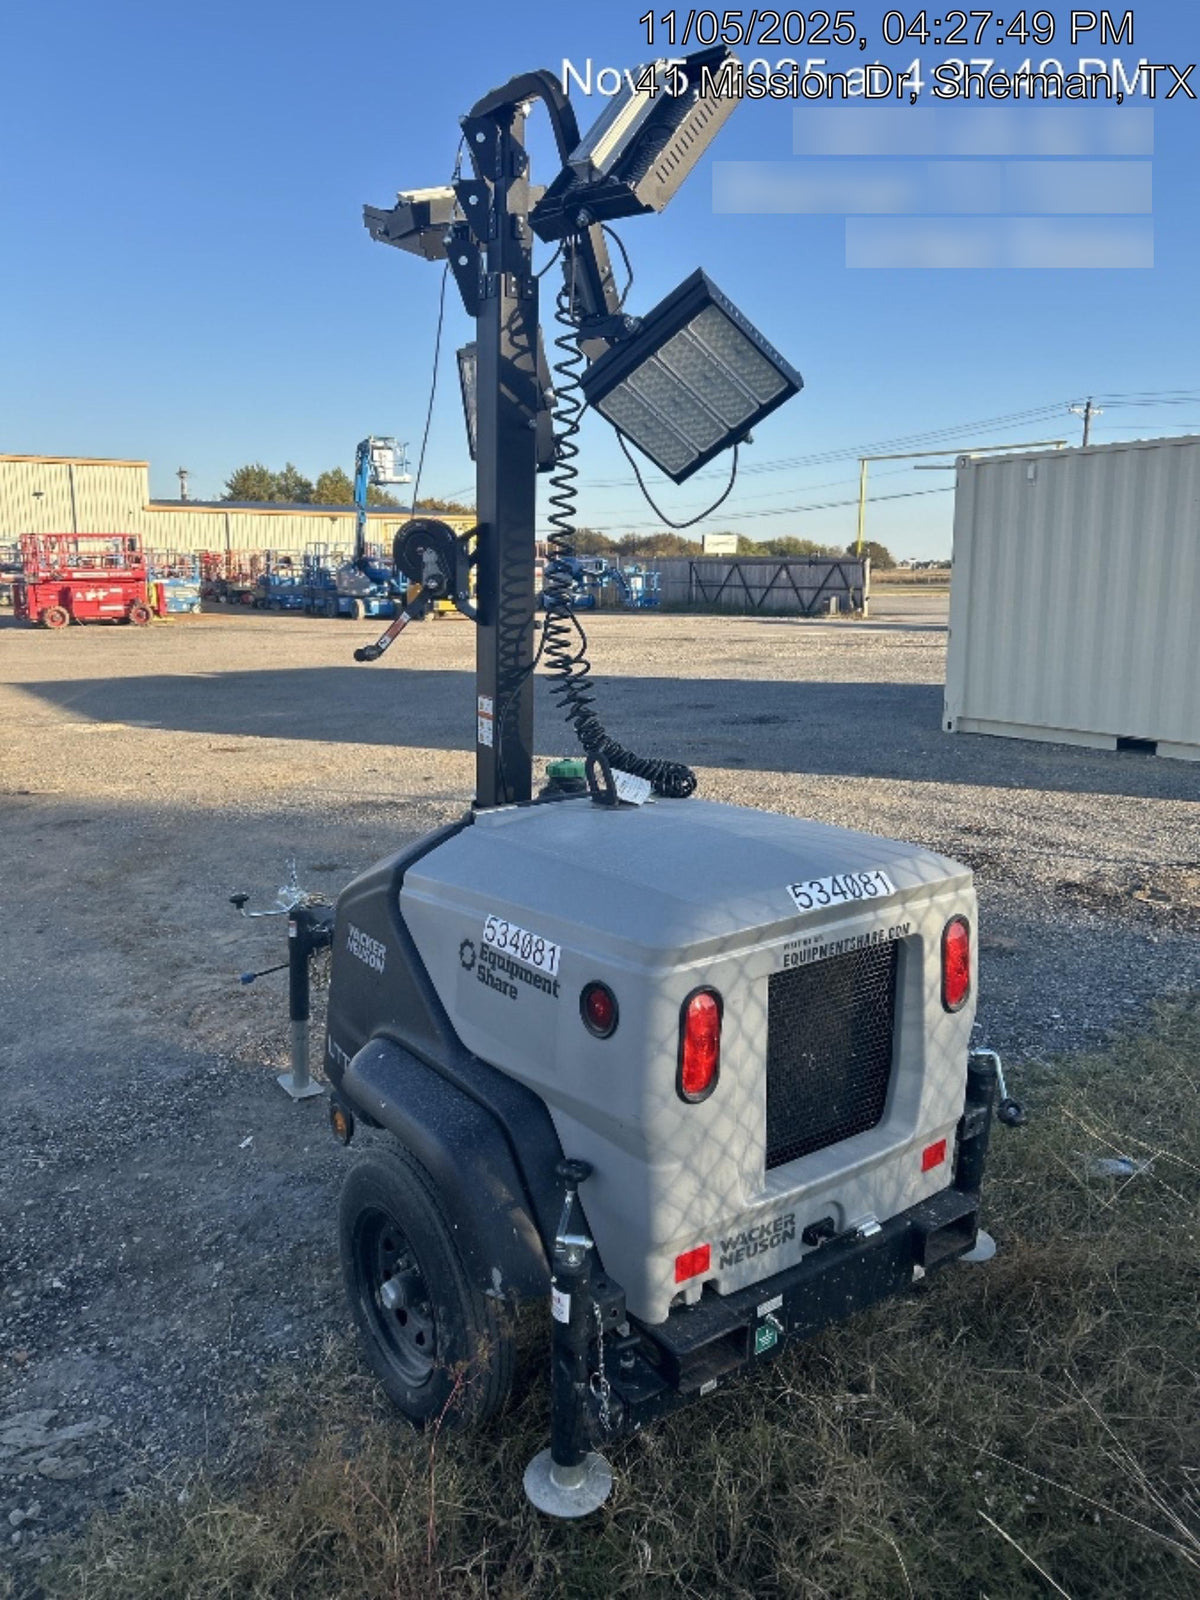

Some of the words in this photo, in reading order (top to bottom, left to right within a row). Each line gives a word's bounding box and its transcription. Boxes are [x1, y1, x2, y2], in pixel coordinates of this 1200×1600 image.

[791, 871, 890, 909] 534081
[485, 916, 556, 972] 534081
[476, 964, 518, 1001] Share
[479, 941, 561, 999] Equipment
[719, 1213, 796, 1254] WACKER
[719, 1226, 796, 1270] NEUSON
